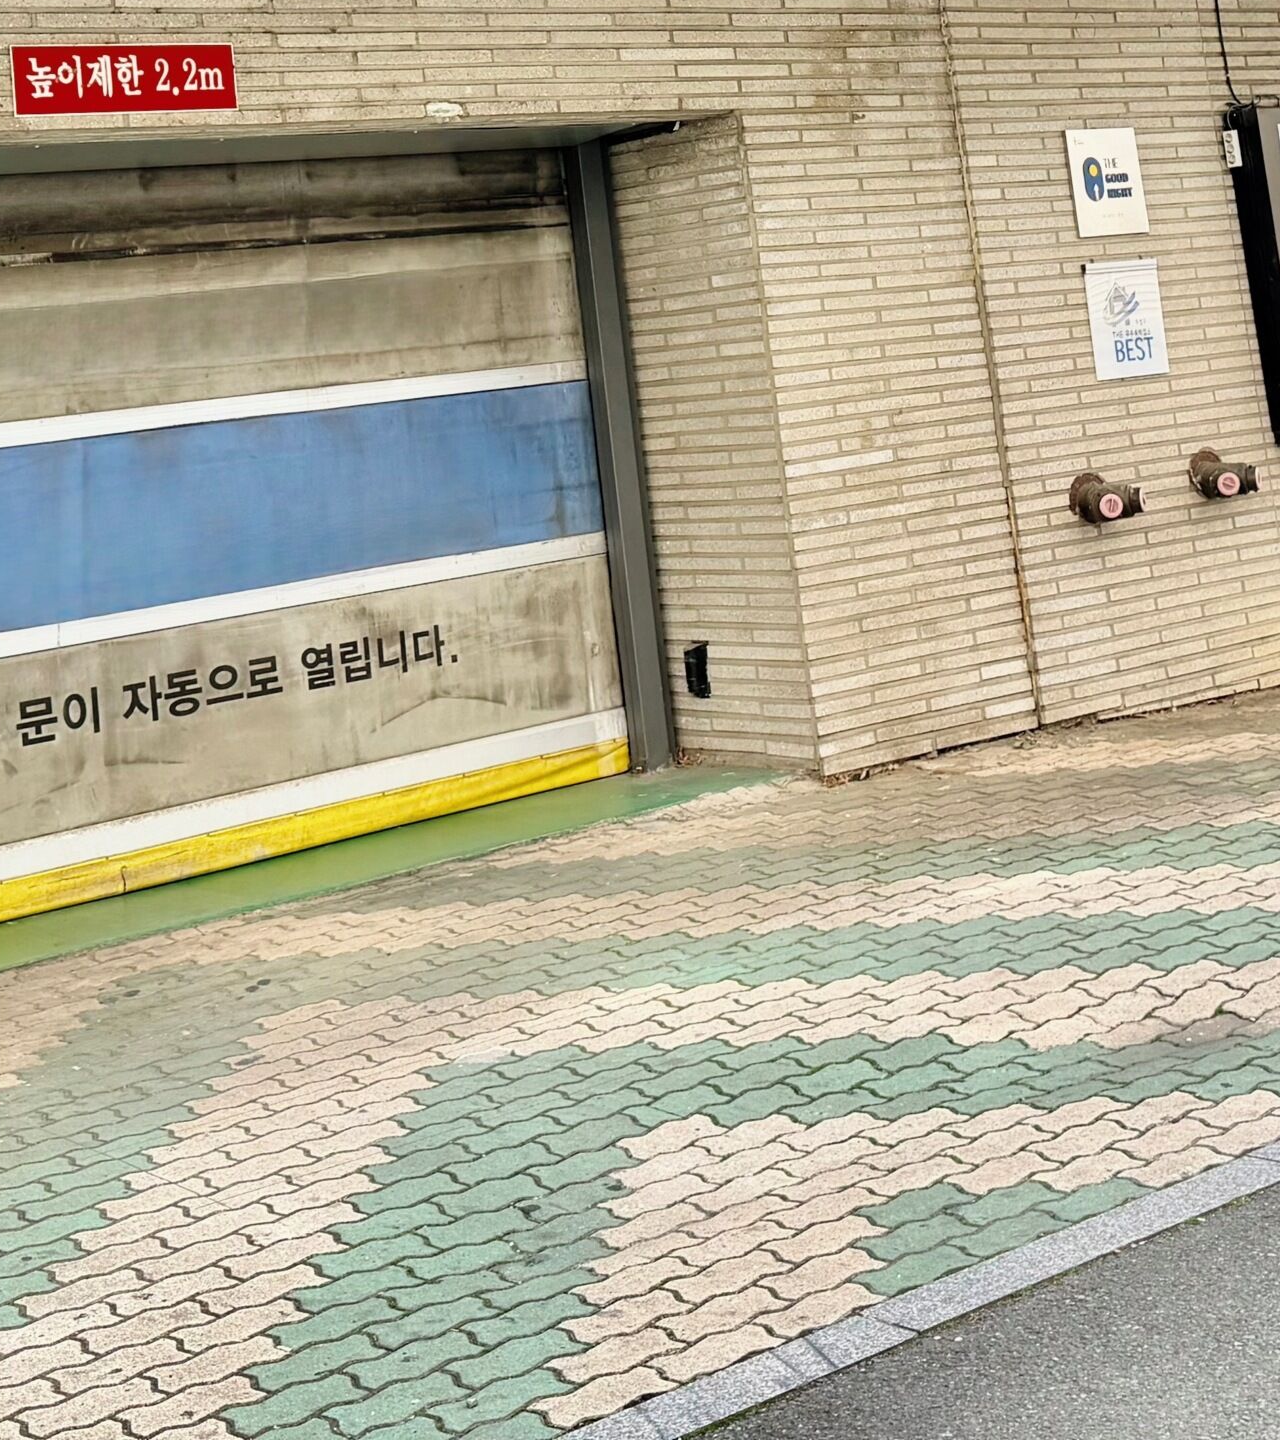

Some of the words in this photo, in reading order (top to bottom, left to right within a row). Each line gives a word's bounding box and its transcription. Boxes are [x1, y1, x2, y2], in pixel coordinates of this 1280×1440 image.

[26, 55, 144, 98] 높이제한
[154, 57, 224, 96] 2.2m
[1105, 172, 1129, 183] GOOD
[1114, 336, 1153, 363] BEST
[16, 686, 101, 747] 문이
[122, 655, 283, 722] 자동으로
[301, 624, 458, 691] 열립니다.
